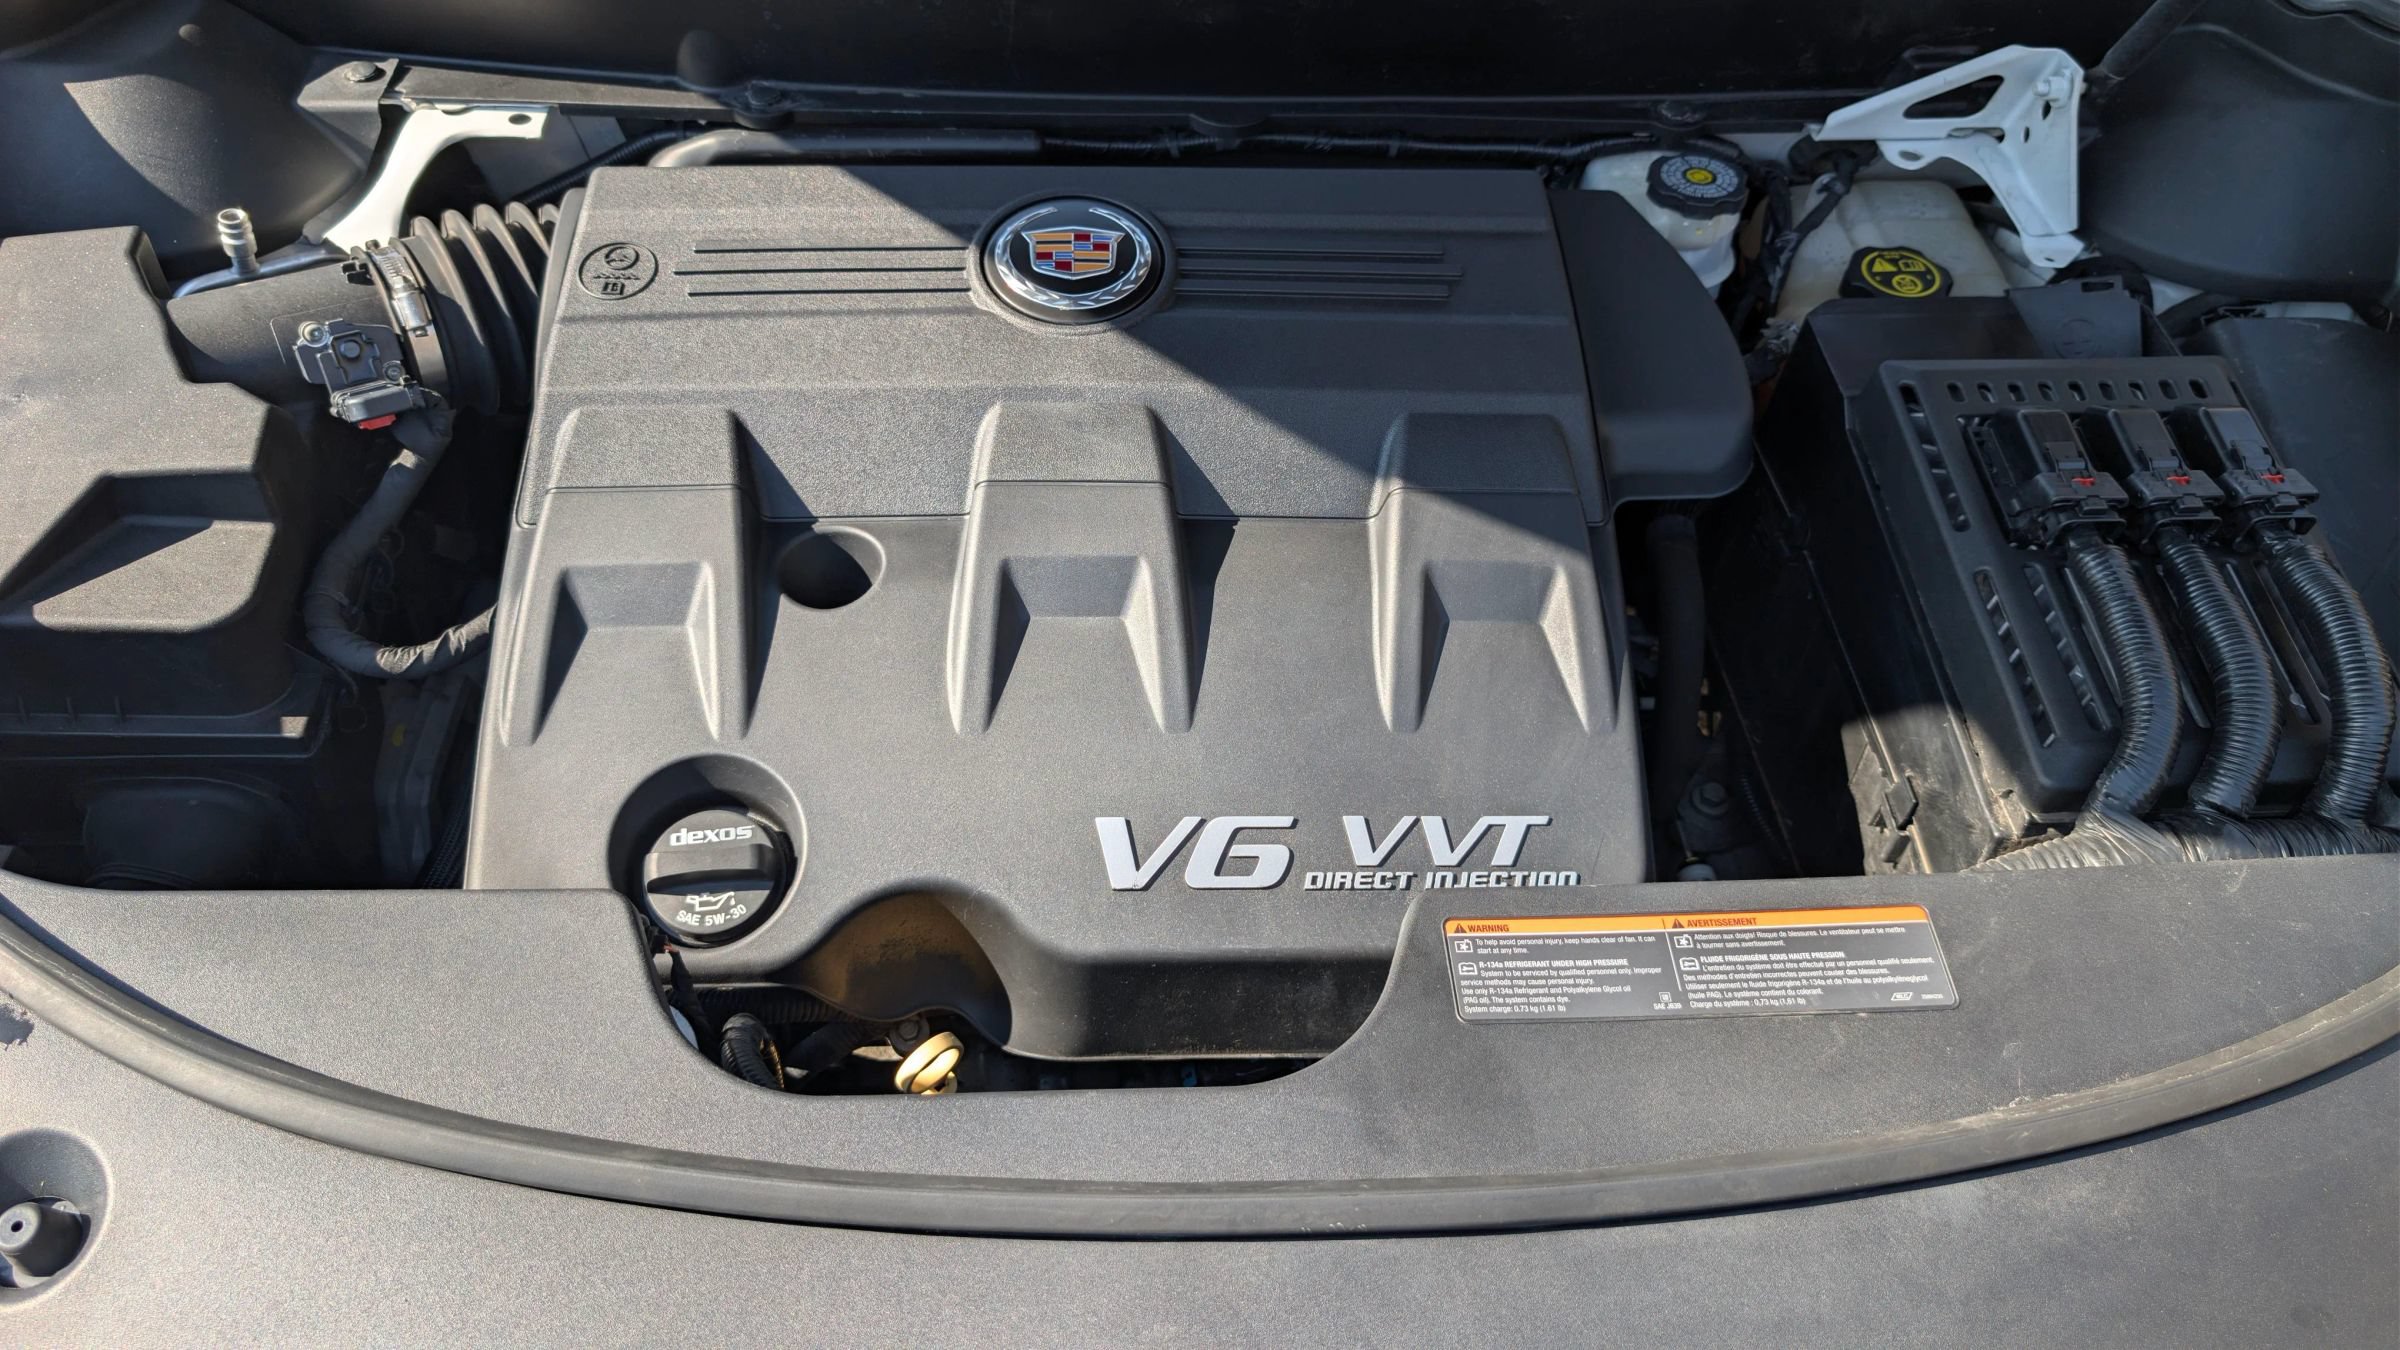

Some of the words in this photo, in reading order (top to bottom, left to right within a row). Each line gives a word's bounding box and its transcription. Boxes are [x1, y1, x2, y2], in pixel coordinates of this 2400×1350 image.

[669, 825, 753, 846] dexos
[1095, 815, 1296, 890] V6
[1342, 815, 1552, 867] VVT
[1303, 871, 1415, 891] DIRECT
[1424, 871, 1580, 888] INJECTION
[676, 910, 701, 926] SAE
[704, 904, 747, 926] 5W-30
[1687, 918, 1757, 927] AVERTISSEMENT
[1468, 924, 1510, 932] WARNING
[1725, 953, 1769, 962] FRIGORIGÈNE
[1846, 959, 1876, 967] personnel
[1878, 958, 1900, 966] qualifié
[1558, 969, 1585, 977] qualified
[1586, 968, 1617, 976] personnel
[1514, 987, 1549, 995] Refrigerant
